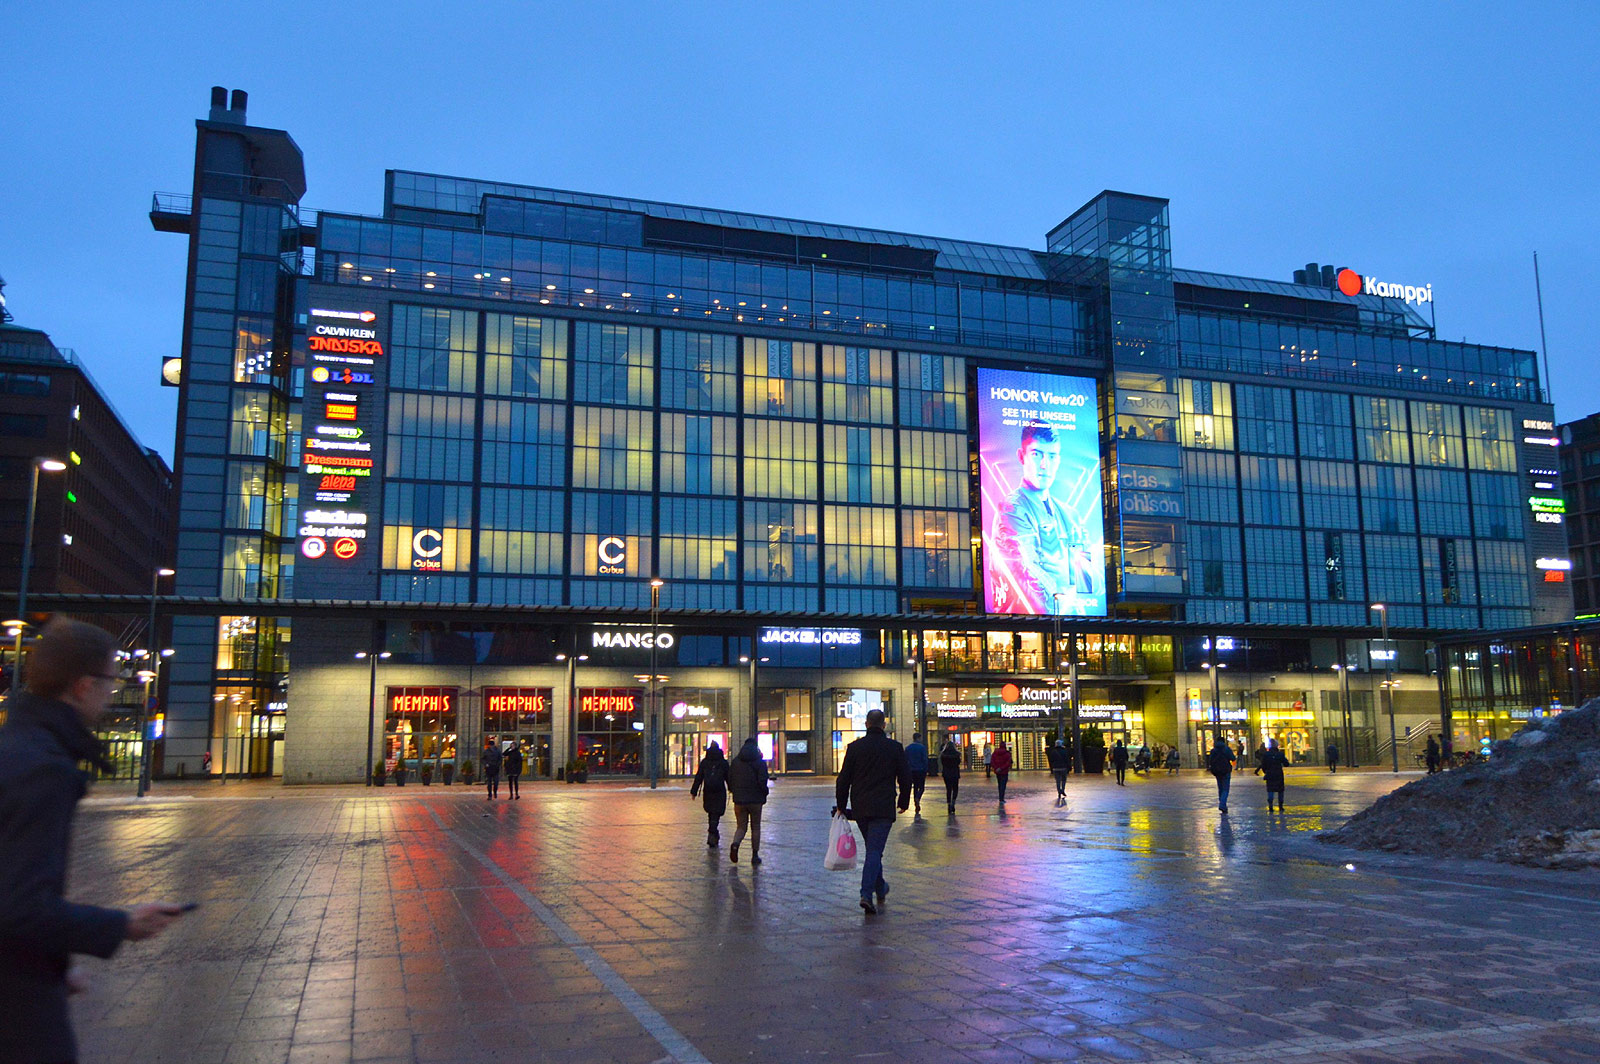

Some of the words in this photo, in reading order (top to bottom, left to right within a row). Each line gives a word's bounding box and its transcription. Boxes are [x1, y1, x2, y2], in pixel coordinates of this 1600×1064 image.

[1365, 276, 1432, 305] Kamppi
[316, 325, 349, 337] CALVIN
[350, 328, 375, 338] KLEIN
[990, 387, 1039, 403] HONOR
[1040, 392, 1085, 407] View20
[1122, 395, 1172, 411] AUKIA
[1002, 407, 1020, 418] SEE
[1020, 409, 1038, 419] THE
[1039, 411, 1076, 422] UNSEEN
[304, 454, 373, 468] Dressmann
[320, 474, 356, 489] alepa
[1122, 470, 1158, 489] clas
[1123, 495, 1180, 515] ohlson
[300, 525, 326, 537] clas
[326, 526, 366, 538] ohlson
[413, 559, 441, 569] Cubus
[599, 565, 625, 575] Cubus
[592, 631, 674, 649] MANGO
[761, 630, 800, 643] JACK
[814, 631, 861, 644] JONES
[1369, 650, 1396, 660] VOLT
[1021, 686, 1071, 703] Kamppi
[392, 694, 450, 712] MEMPHIS
[488, 695, 545, 712] MEMPHIS
[581, 695, 635, 712] MEMPHIS
[937, 703, 976, 711] Metroasema
[937, 710, 977, 718] Metrostation
